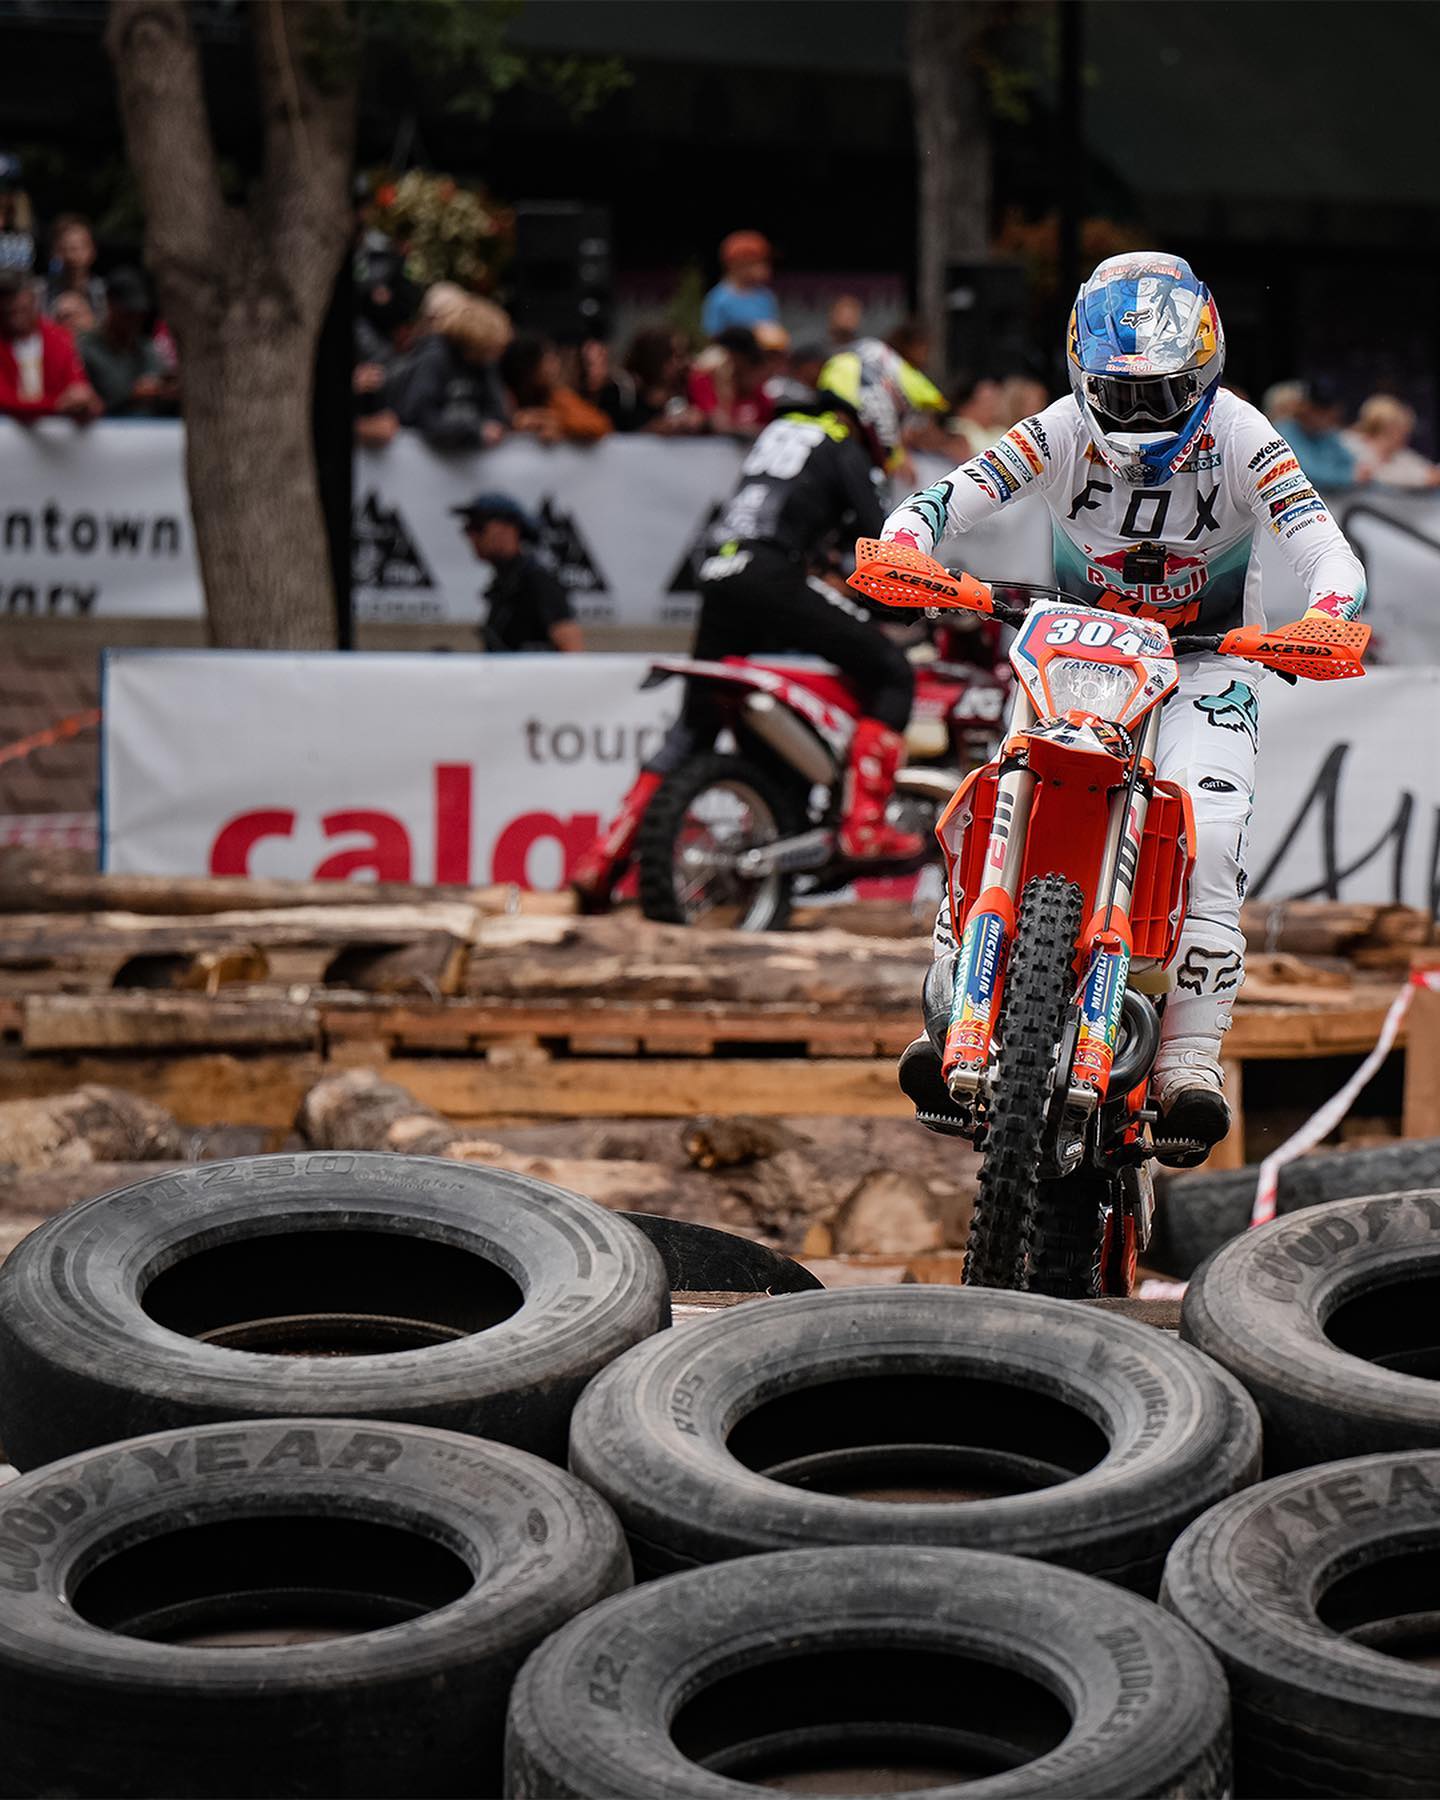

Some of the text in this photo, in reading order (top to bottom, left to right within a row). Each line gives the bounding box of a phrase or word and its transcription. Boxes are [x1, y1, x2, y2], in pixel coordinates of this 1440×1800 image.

[1067, 480, 1221, 542] FOX
[884, 569, 959, 597] ACERBIS
[1086, 565, 1209, 602] Red Bull
[1044, 618, 1144, 657] 304
[1256, 642, 1333, 657] ACERBIS
[1062, 660, 1123, 677] FARIOLI
[979, 919, 1001, 995] MICHELIN
[1110, 953, 1130, 1025] MOTOREX
